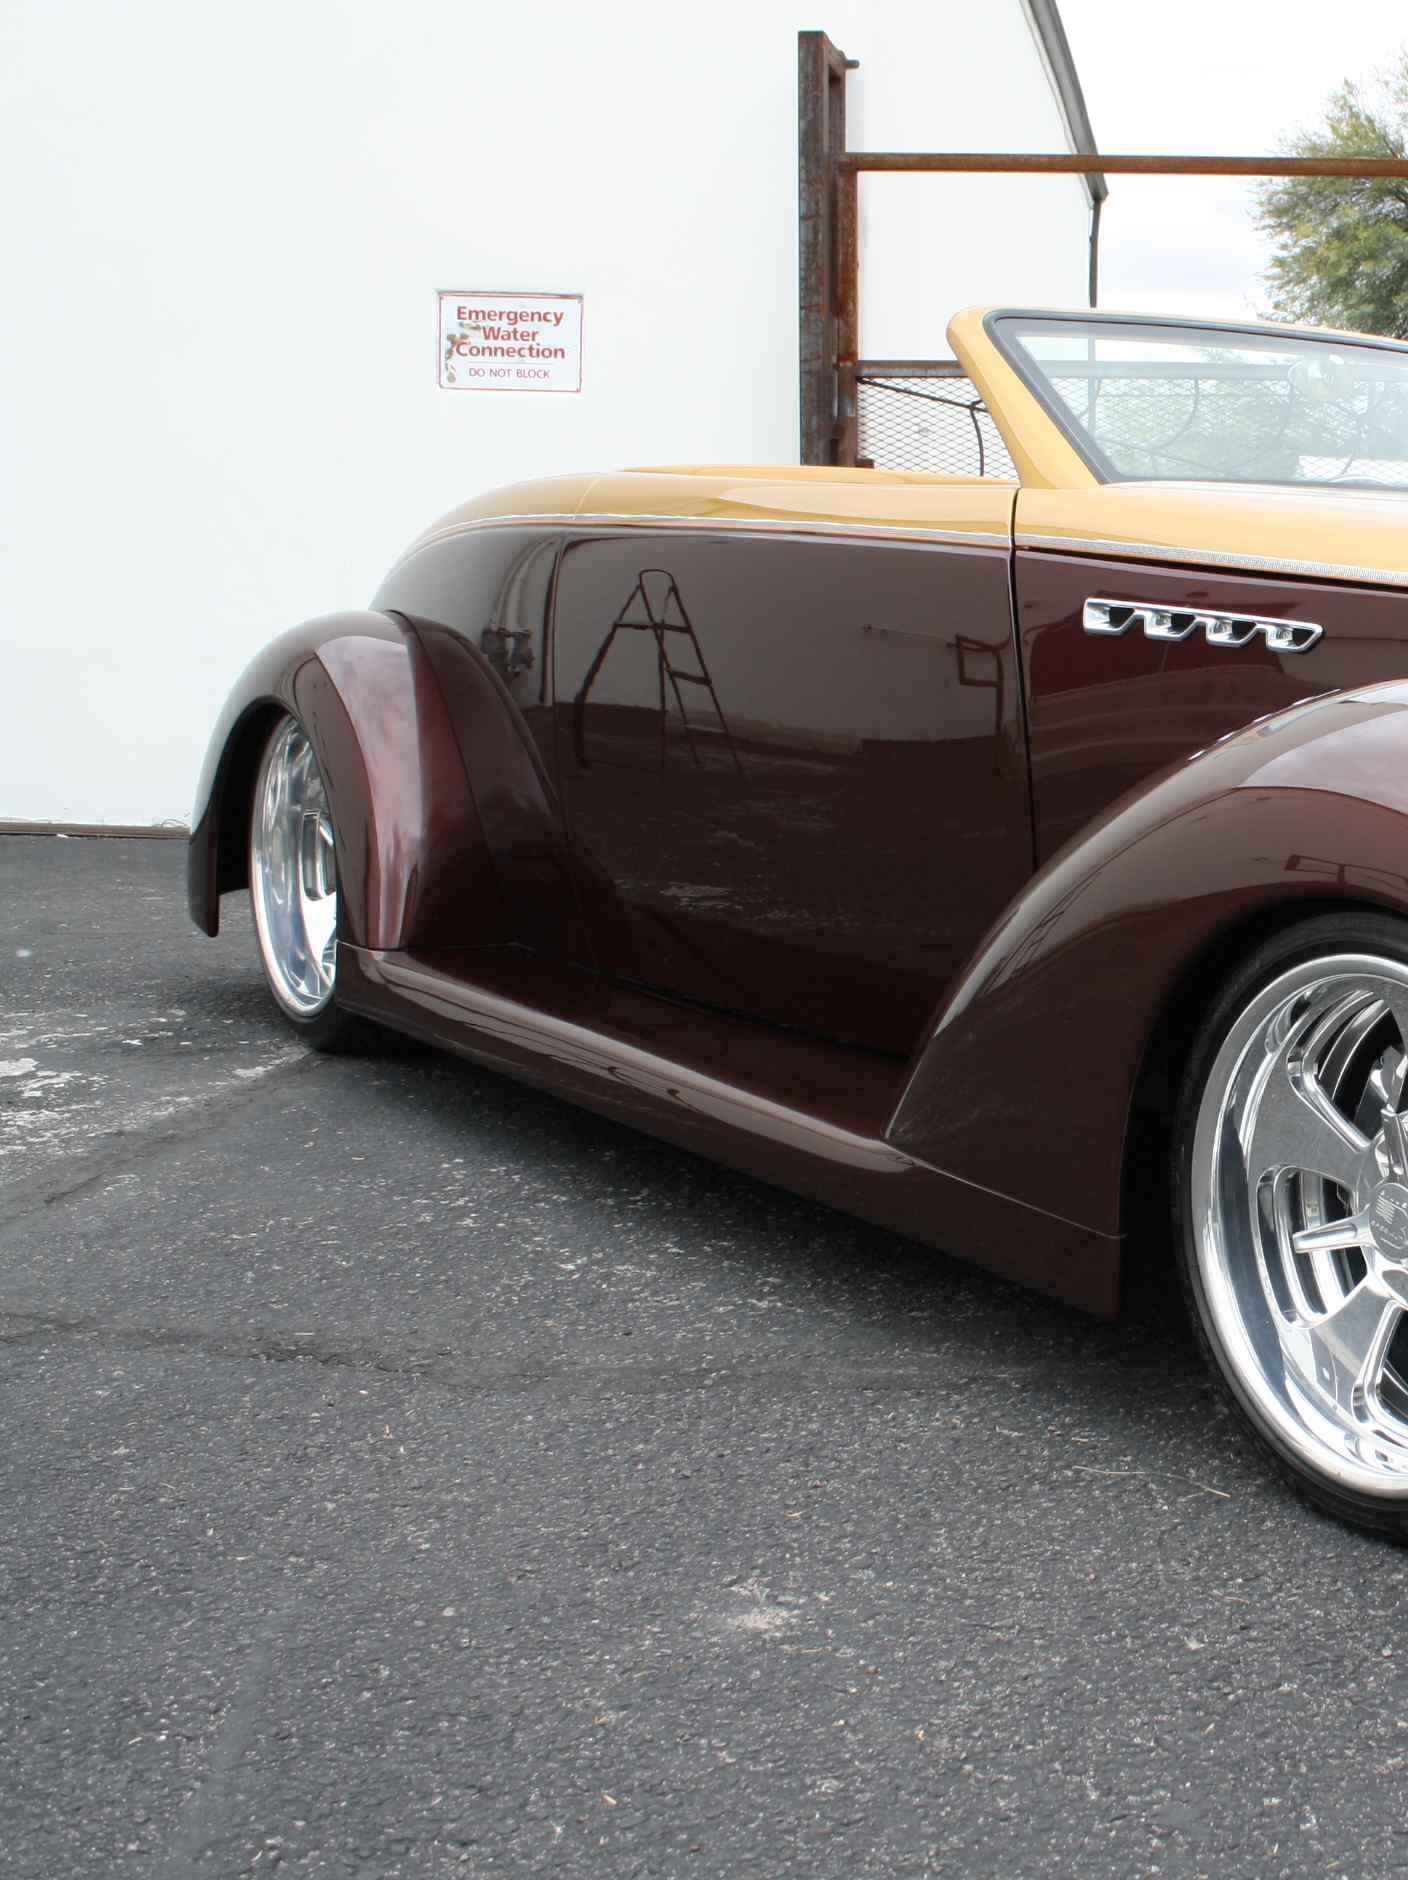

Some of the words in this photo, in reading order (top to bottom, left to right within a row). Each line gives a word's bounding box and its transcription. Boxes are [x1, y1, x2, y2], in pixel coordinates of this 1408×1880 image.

[457, 306, 564, 326] Emergency
[482, 326, 540, 342] Water
[455, 342, 565, 359] Connection
[469, 368, 485, 377] DO
[490, 368, 512, 378] NOT
[516, 369, 550, 379] BLOCK
